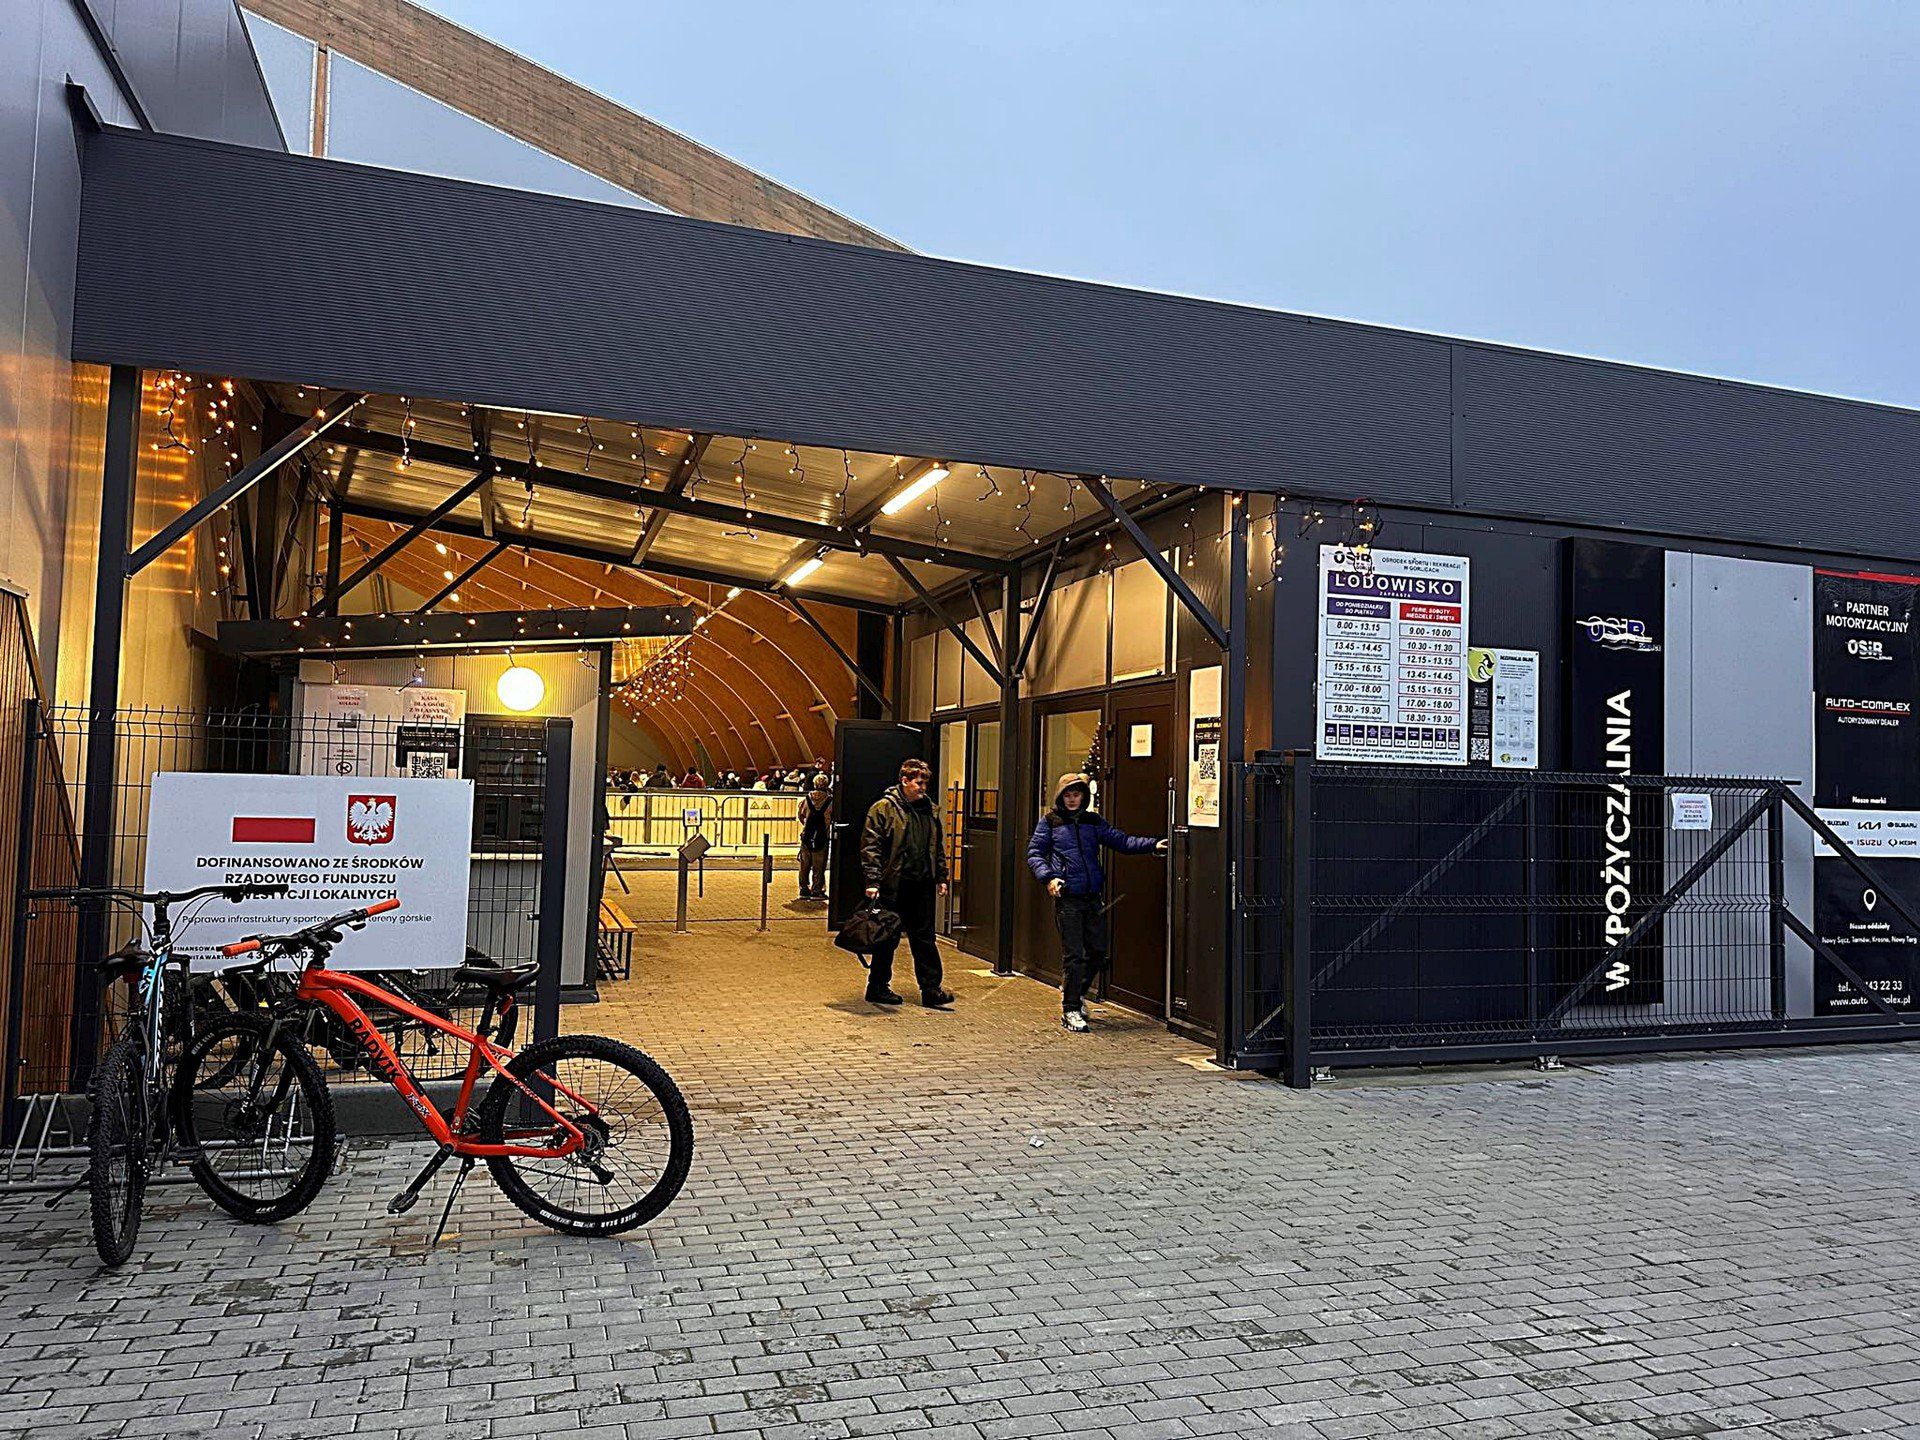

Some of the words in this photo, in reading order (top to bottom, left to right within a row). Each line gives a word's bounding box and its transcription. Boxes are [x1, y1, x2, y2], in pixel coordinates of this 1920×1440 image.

[1335, 573, 1454, 595] LODOWISKO
[1846, 601, 1889, 617] PARTNER
[1337, 621, 1353, 629] 8.00
[1360, 623, 1380, 631] 13.15
[1826, 614, 1909, 633] MOTORYZACYJNY
[1409, 627, 1425, 635] 9.00
[1432, 629, 1452, 637] 10.00
[1334, 642, 1355, 650] 13.45
[1361, 643, 1382, 652] 14.45
[1407, 642, 1427, 650] 10.30
[1407, 655, 1427, 663] 12.15
[1433, 657, 1453, 665] 13.15
[1334, 662, 1355, 671] 15.15
[1407, 670, 1427, 678] 13.45
[1433, 672, 1453, 680] 14.45
[1334, 684, 1354, 692] 17.00
[1361, 685, 1381, 693] 18.00
[1406, 685, 1426, 693] 15.15
[1433, 687, 1453, 695] 16.15
[1333, 705, 1353, 713] 18.30
[1361, 706, 1381, 714] 19.30
[1406, 700, 1426, 708] 17.00
[1433, 701, 1453, 709] 18.00
[1825, 698, 1910, 711] AUTO-COMPLEX
[1406, 714, 1426, 722] 18.30
[1433, 715, 1453, 723] 19.30
[1837, 717, 1879, 725] AUTORYZOWANY
[196, 857, 330, 868] DOFINANSOWANO
[332, 858, 348, 868] ZE
[351, 855, 424, 869] ŚRODKÓW
[225, 873, 320, 884] RZĄDOWEGO
[322, 873, 396, 884] FUNDUSZU
[222, 889, 310, 900] ESTYCJI
[313, 889, 397, 900] LOKALNYCH
[182, 915, 226, 925] Poprawa
[228, 914, 291, 925] infrastruktury
[400, 913, 432, 925] górskie
[1838, 981, 1851, 992] tel.
[1880, 980, 1891, 990] 22
[1892, 980, 1903, 990] 33
